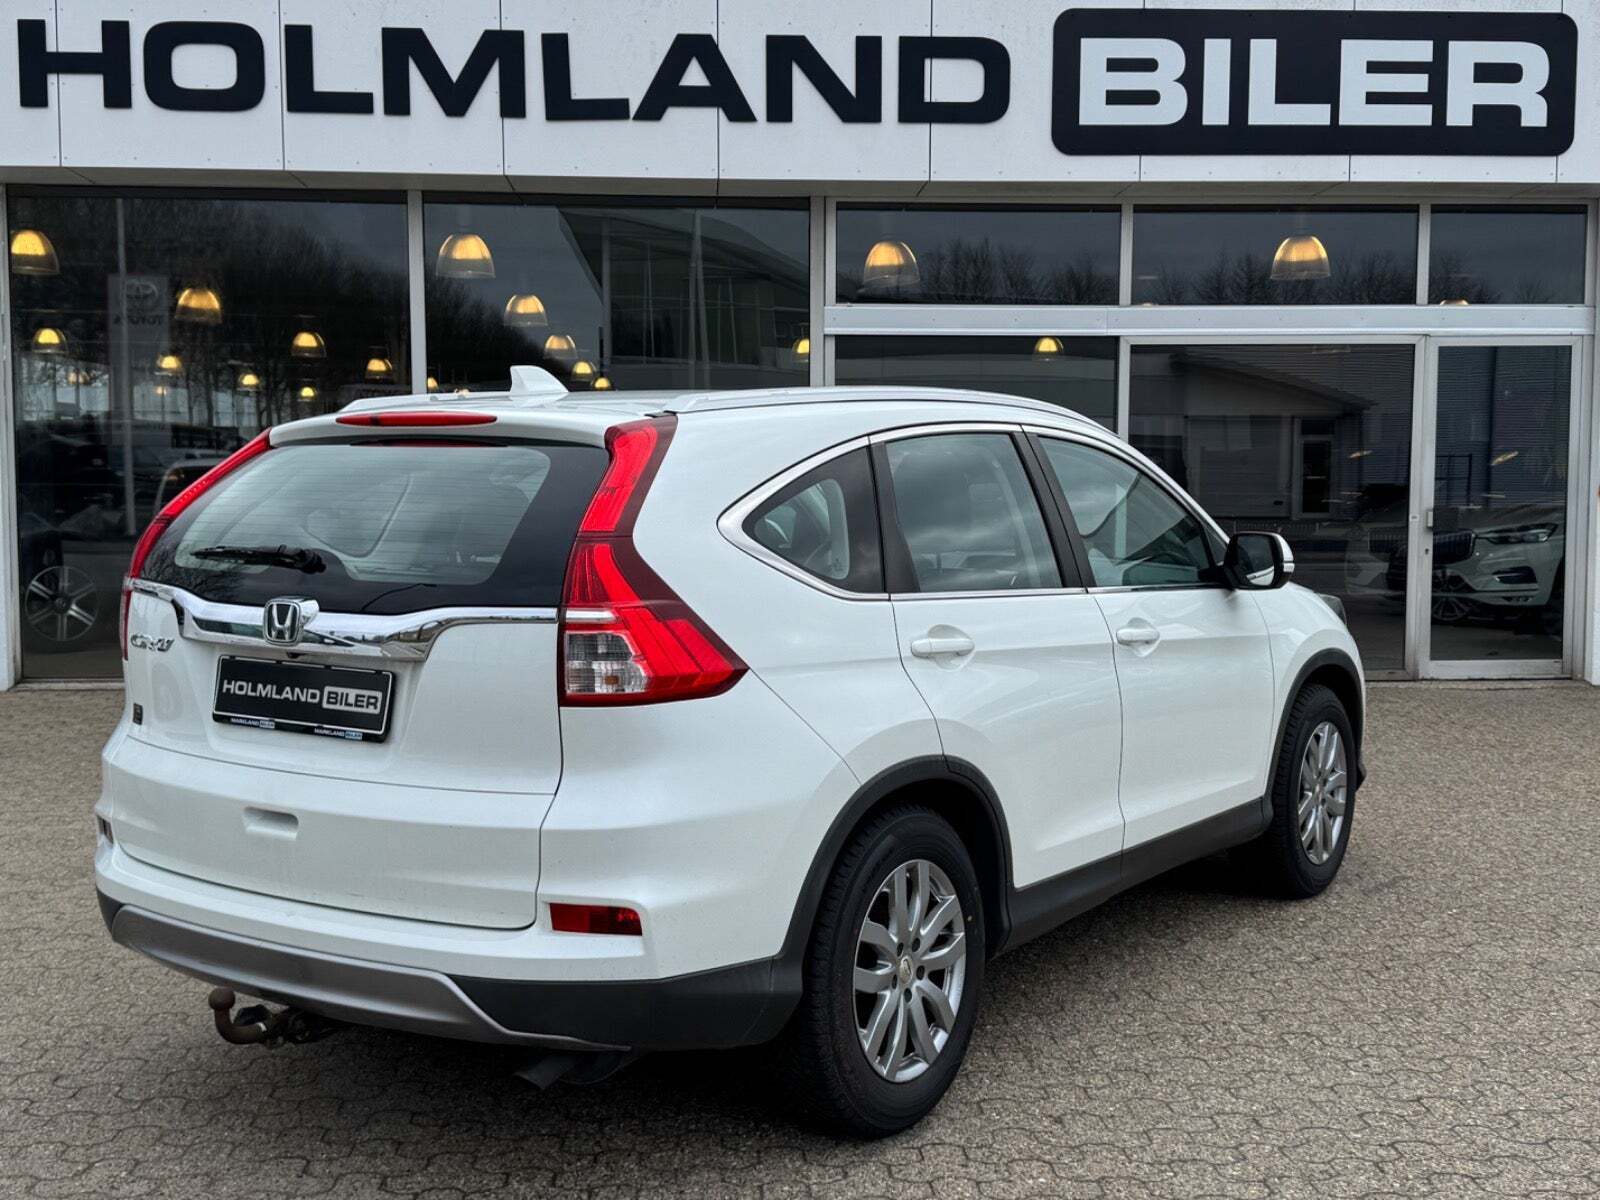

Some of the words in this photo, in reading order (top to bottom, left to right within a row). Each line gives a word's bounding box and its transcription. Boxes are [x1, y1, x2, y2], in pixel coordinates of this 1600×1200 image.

[17, 19, 1011, 124] HOLMLAND
[1078, 37, 1550, 128] BILER
[222, 679, 320, 704] HOLMLAND
[325, 689, 380, 711] BILER
[231, 717, 260, 727] MARKLAND
[314, 728, 345, 738] MARKLAND
